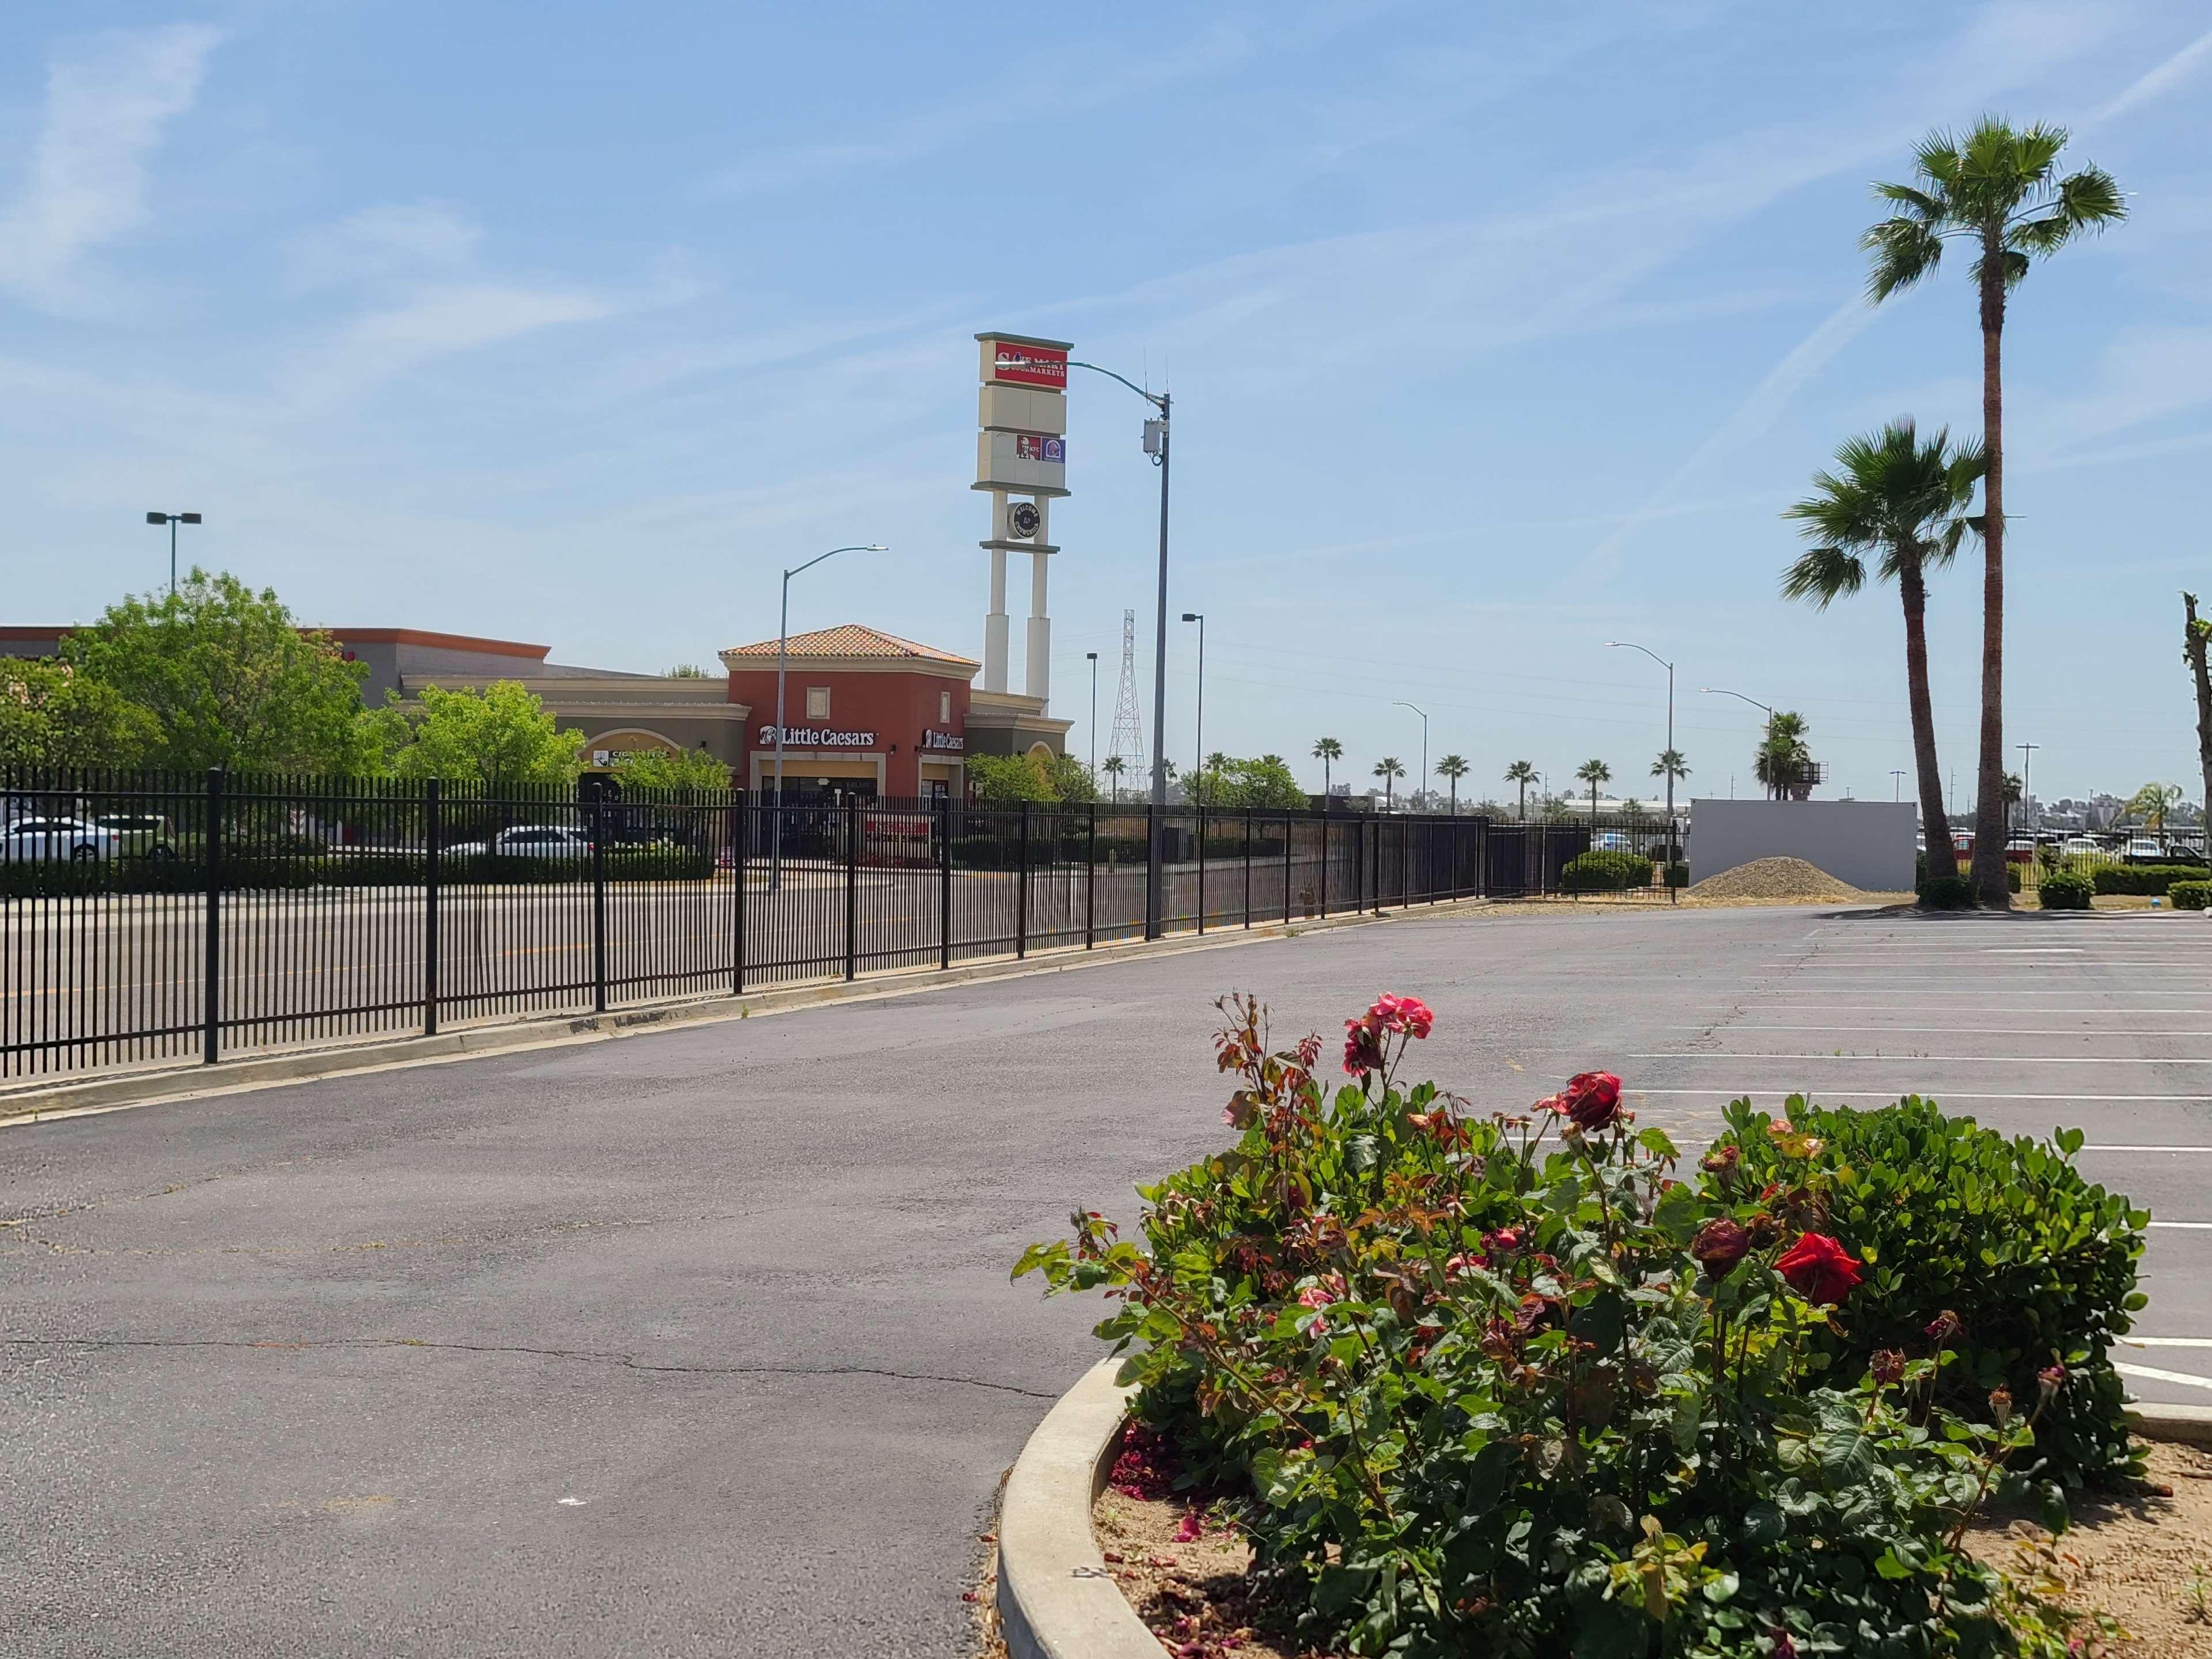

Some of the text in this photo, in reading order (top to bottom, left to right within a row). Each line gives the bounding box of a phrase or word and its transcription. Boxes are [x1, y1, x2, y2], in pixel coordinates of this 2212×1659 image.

[1016, 505, 1039, 517] WELCOME
[781, 728, 874, 745] Little Caesars
[933, 732, 964, 749] Little Caesars
